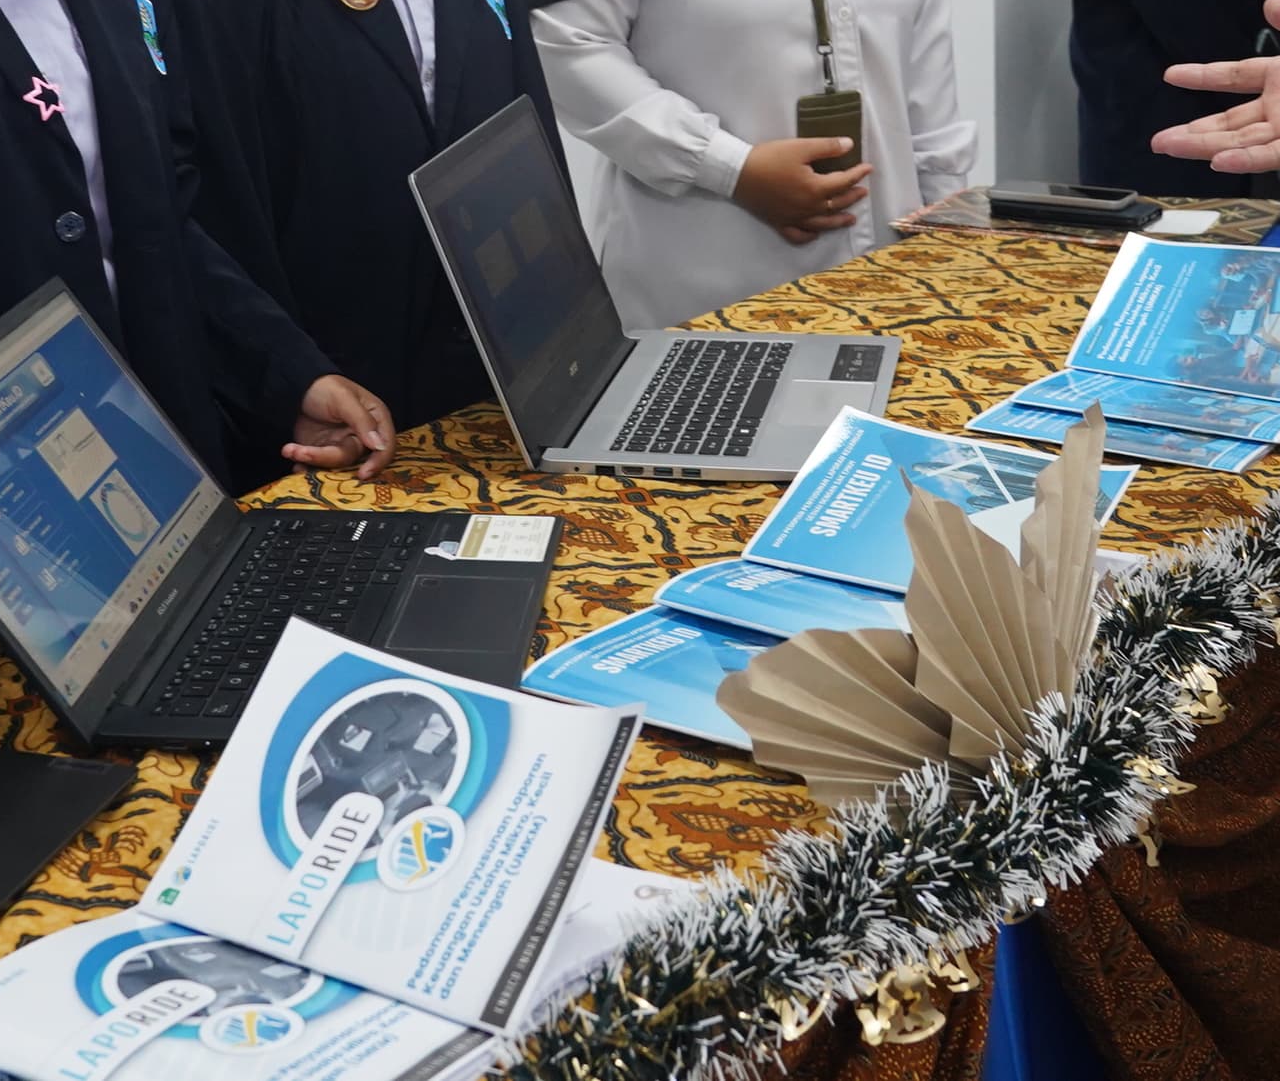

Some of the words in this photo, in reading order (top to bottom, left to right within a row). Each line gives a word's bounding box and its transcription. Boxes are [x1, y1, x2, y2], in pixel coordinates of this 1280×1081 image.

[809, 470, 881, 537] SMARTKEU
[862, 454, 893, 471] ID
[592, 630, 685, 674] SMARTKEU
[267, 807, 372, 946] LAPORIDE
[407, 913, 457, 990] Pedoman
[452, 812, 512, 909] Penyusunan
[509, 752, 547, 813] Laporan
[422, 911, 476, 995] Keuangan
[470, 861, 506, 909] Usaha
[499, 810, 534, 861] Mikro,
[530, 771, 553, 807] Kecil
[439, 969, 459, 1000] dan
[456, 878, 512, 964] Menengah
[506, 814, 548, 878] (UMKM)
[59, 986, 200, 1081] LAPORIDE
